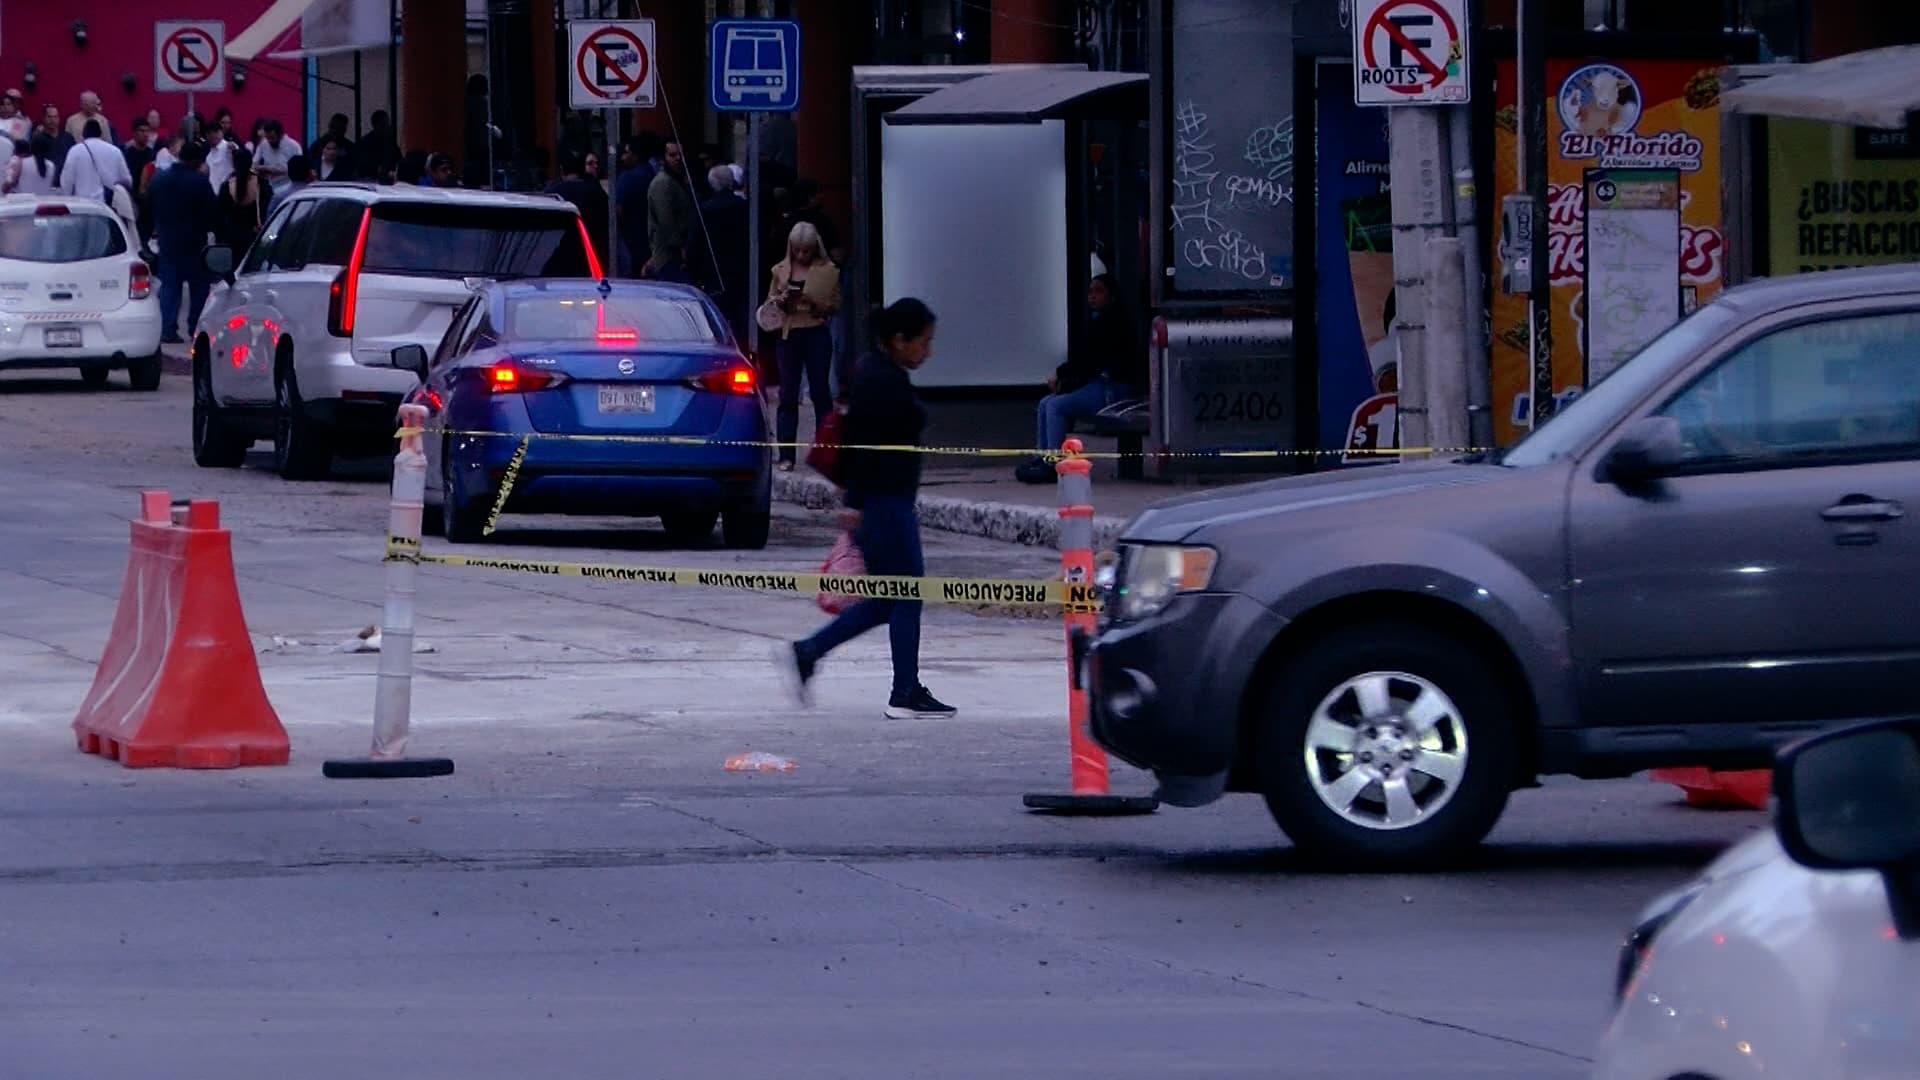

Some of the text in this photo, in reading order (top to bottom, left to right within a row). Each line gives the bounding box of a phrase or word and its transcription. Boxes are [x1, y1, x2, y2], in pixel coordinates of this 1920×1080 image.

[1361, 69, 1417, 84] ROOTS
[1564, 135, 1698, 156] El Florido
[1799, 180, 1919, 221] ¿BUSCAS
[1194, 391, 1283, 421] 22406
